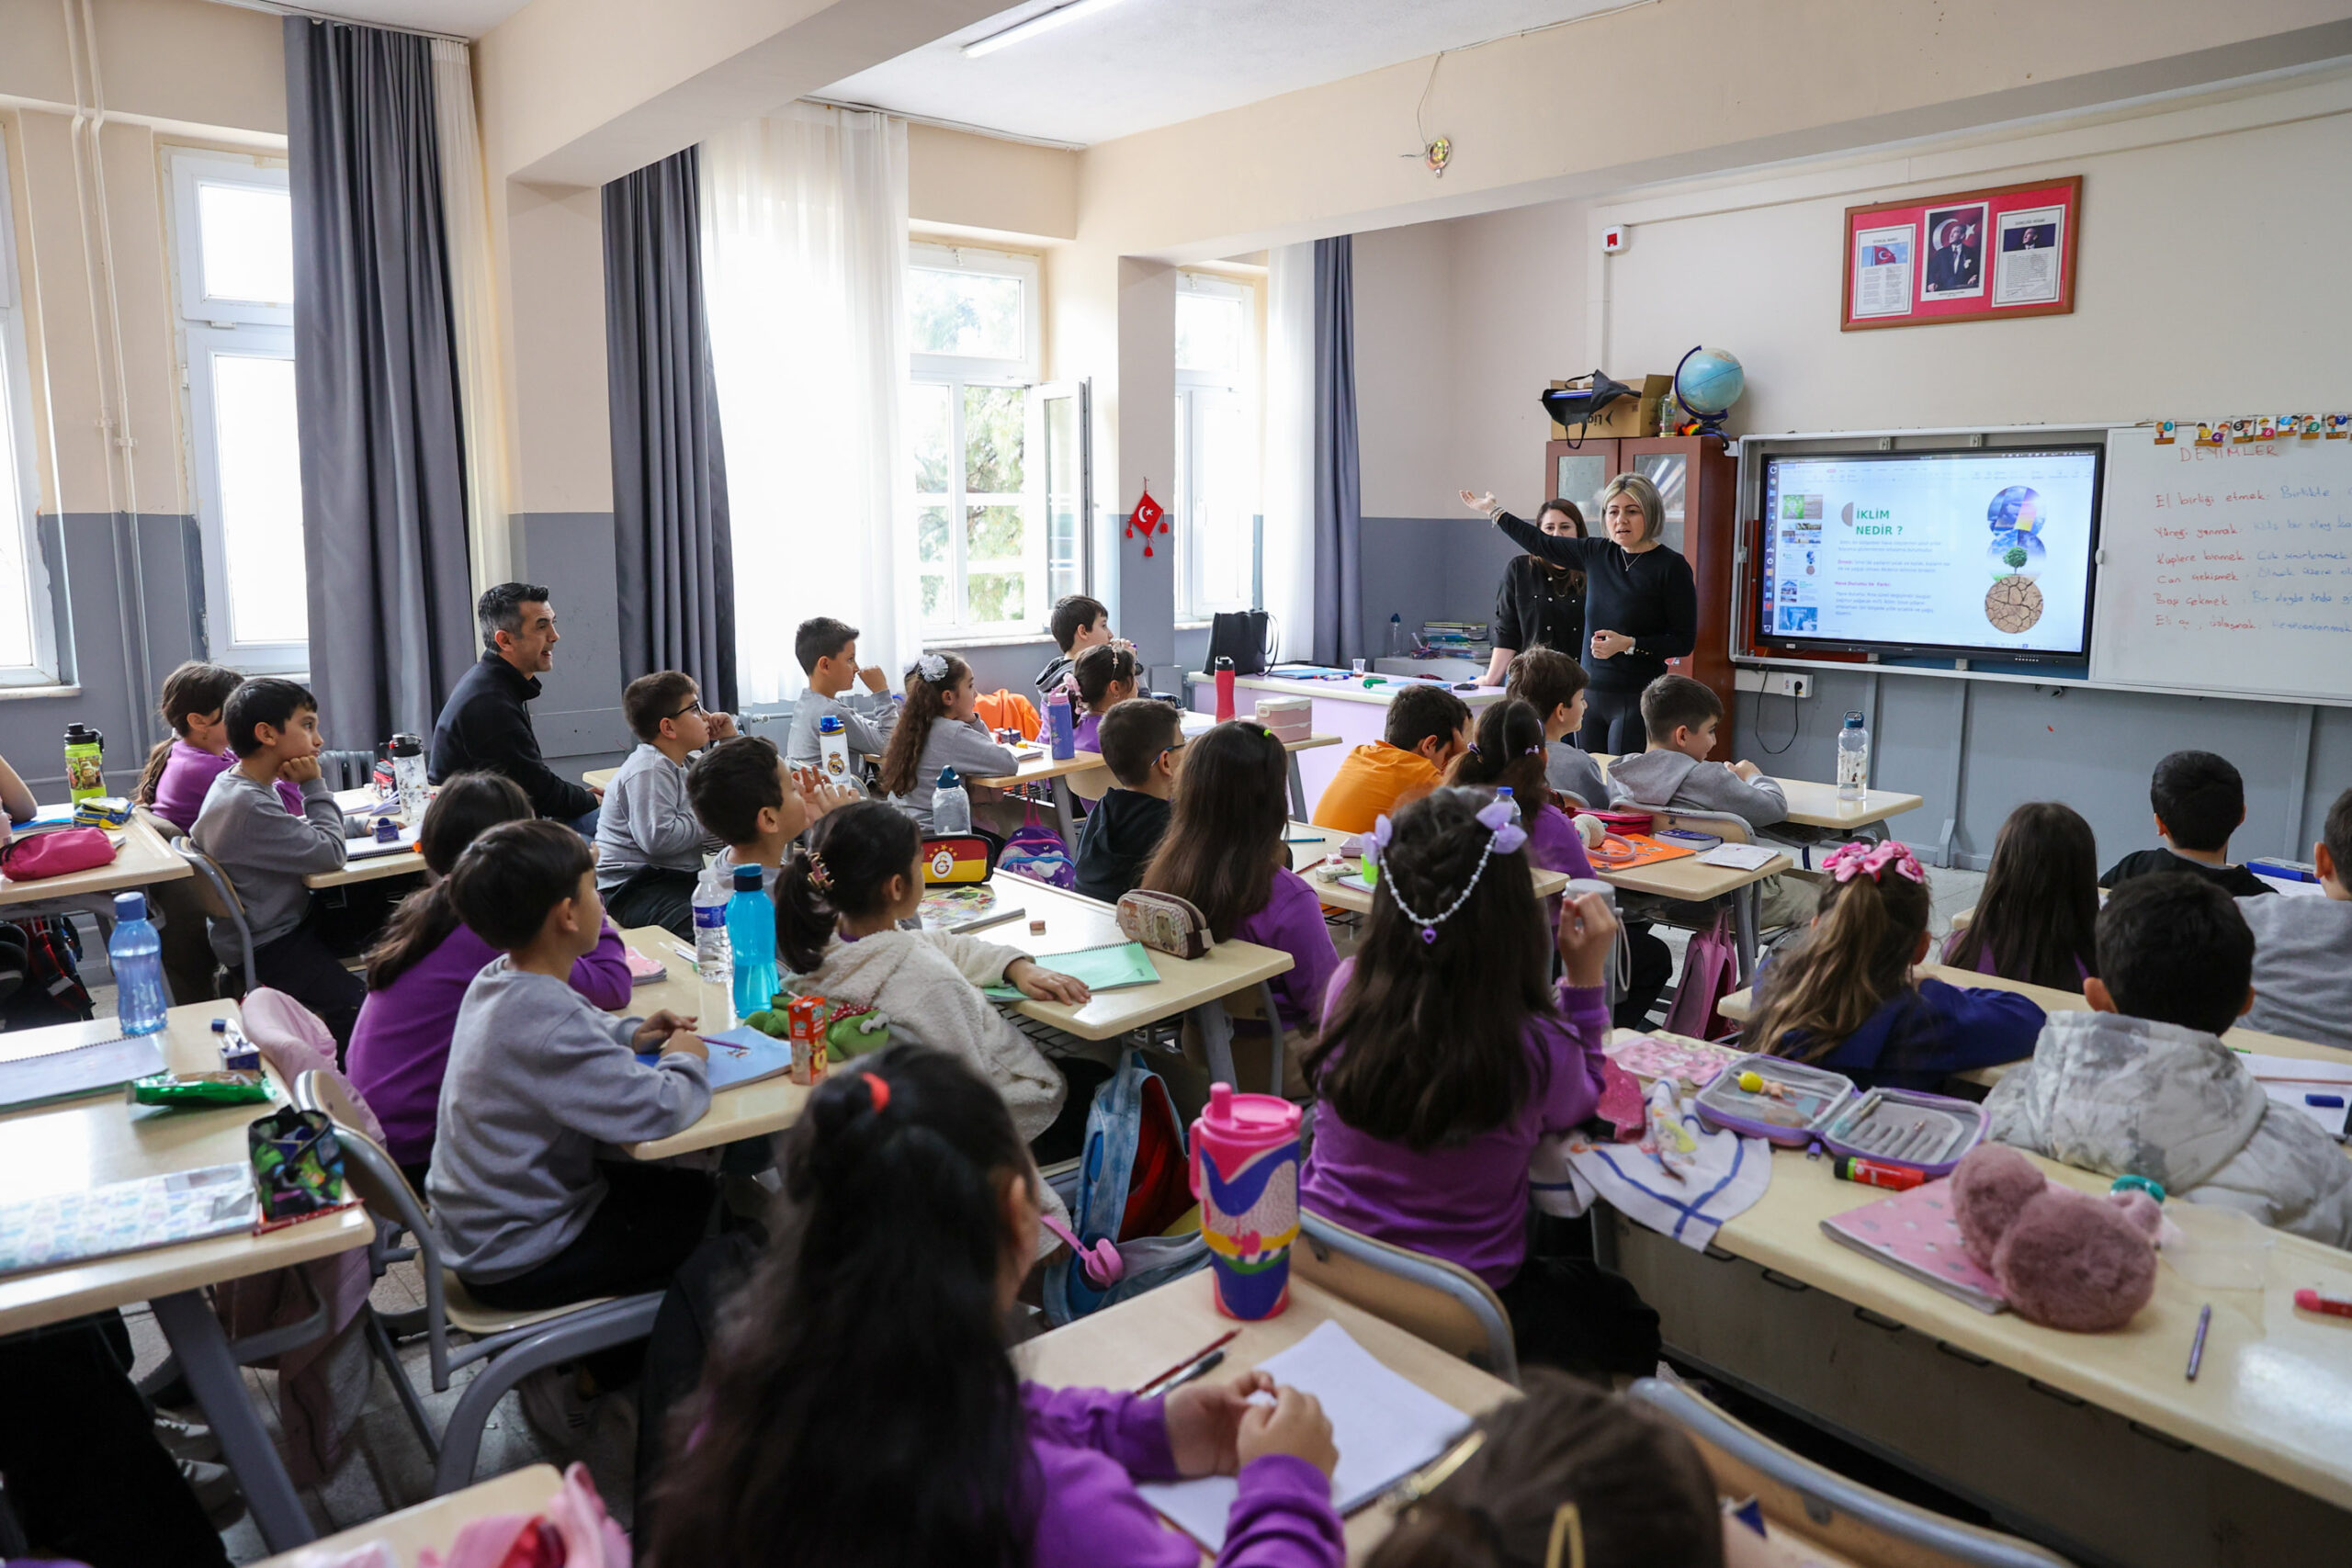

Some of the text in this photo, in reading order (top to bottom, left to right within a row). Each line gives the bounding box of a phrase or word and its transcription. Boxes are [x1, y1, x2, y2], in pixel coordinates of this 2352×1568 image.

[1857, 507, 1890, 520] İKLİM
[1856, 523, 1904, 536] NEDİR ?
[2156, 575, 2182, 584] Can
